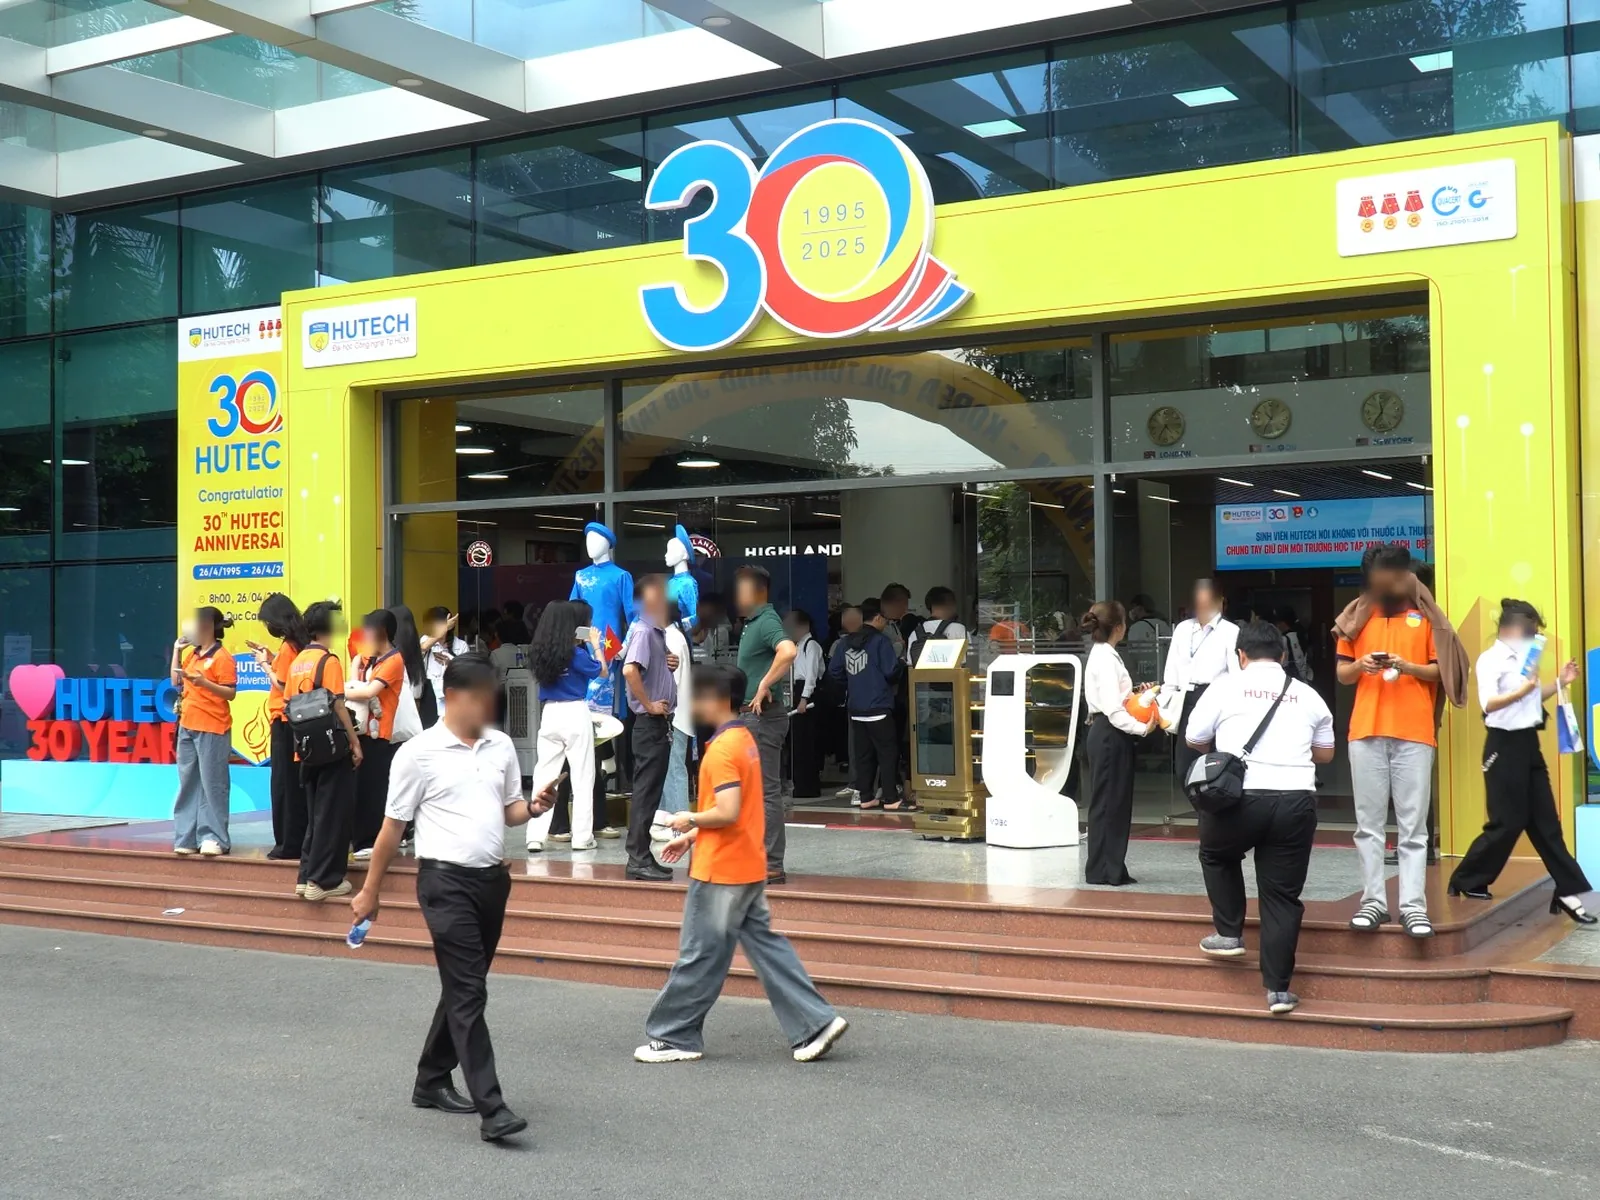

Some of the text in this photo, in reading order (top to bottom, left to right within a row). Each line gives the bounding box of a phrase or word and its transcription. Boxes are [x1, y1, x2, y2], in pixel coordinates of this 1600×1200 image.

[802, 202, 866, 226] 1995
[640, 118, 962, 352] 30
[802, 236, 866, 261] 2025
[203, 322, 250, 340] HUTECH
[332, 313, 409, 340] HUTECH
[206, 370, 283, 438] 30
[231, 511, 283, 530] HUTEC
[1232, 510, 1261, 518] HUTECH
[194, 532, 283, 552] ANNIVERSA
[1256, 531, 1272, 542] SINH
[1290, 529, 1317, 541] HUTECH
[1226, 545, 1249, 555] CHUNG
[1251, 544, 1262, 555] TAY
[199, 566, 241, 577] 26/4/1995
[245, 611, 258, 621] Ca
[1244, 689, 1298, 703] HUTECH
[26, 720, 79, 761] 30
